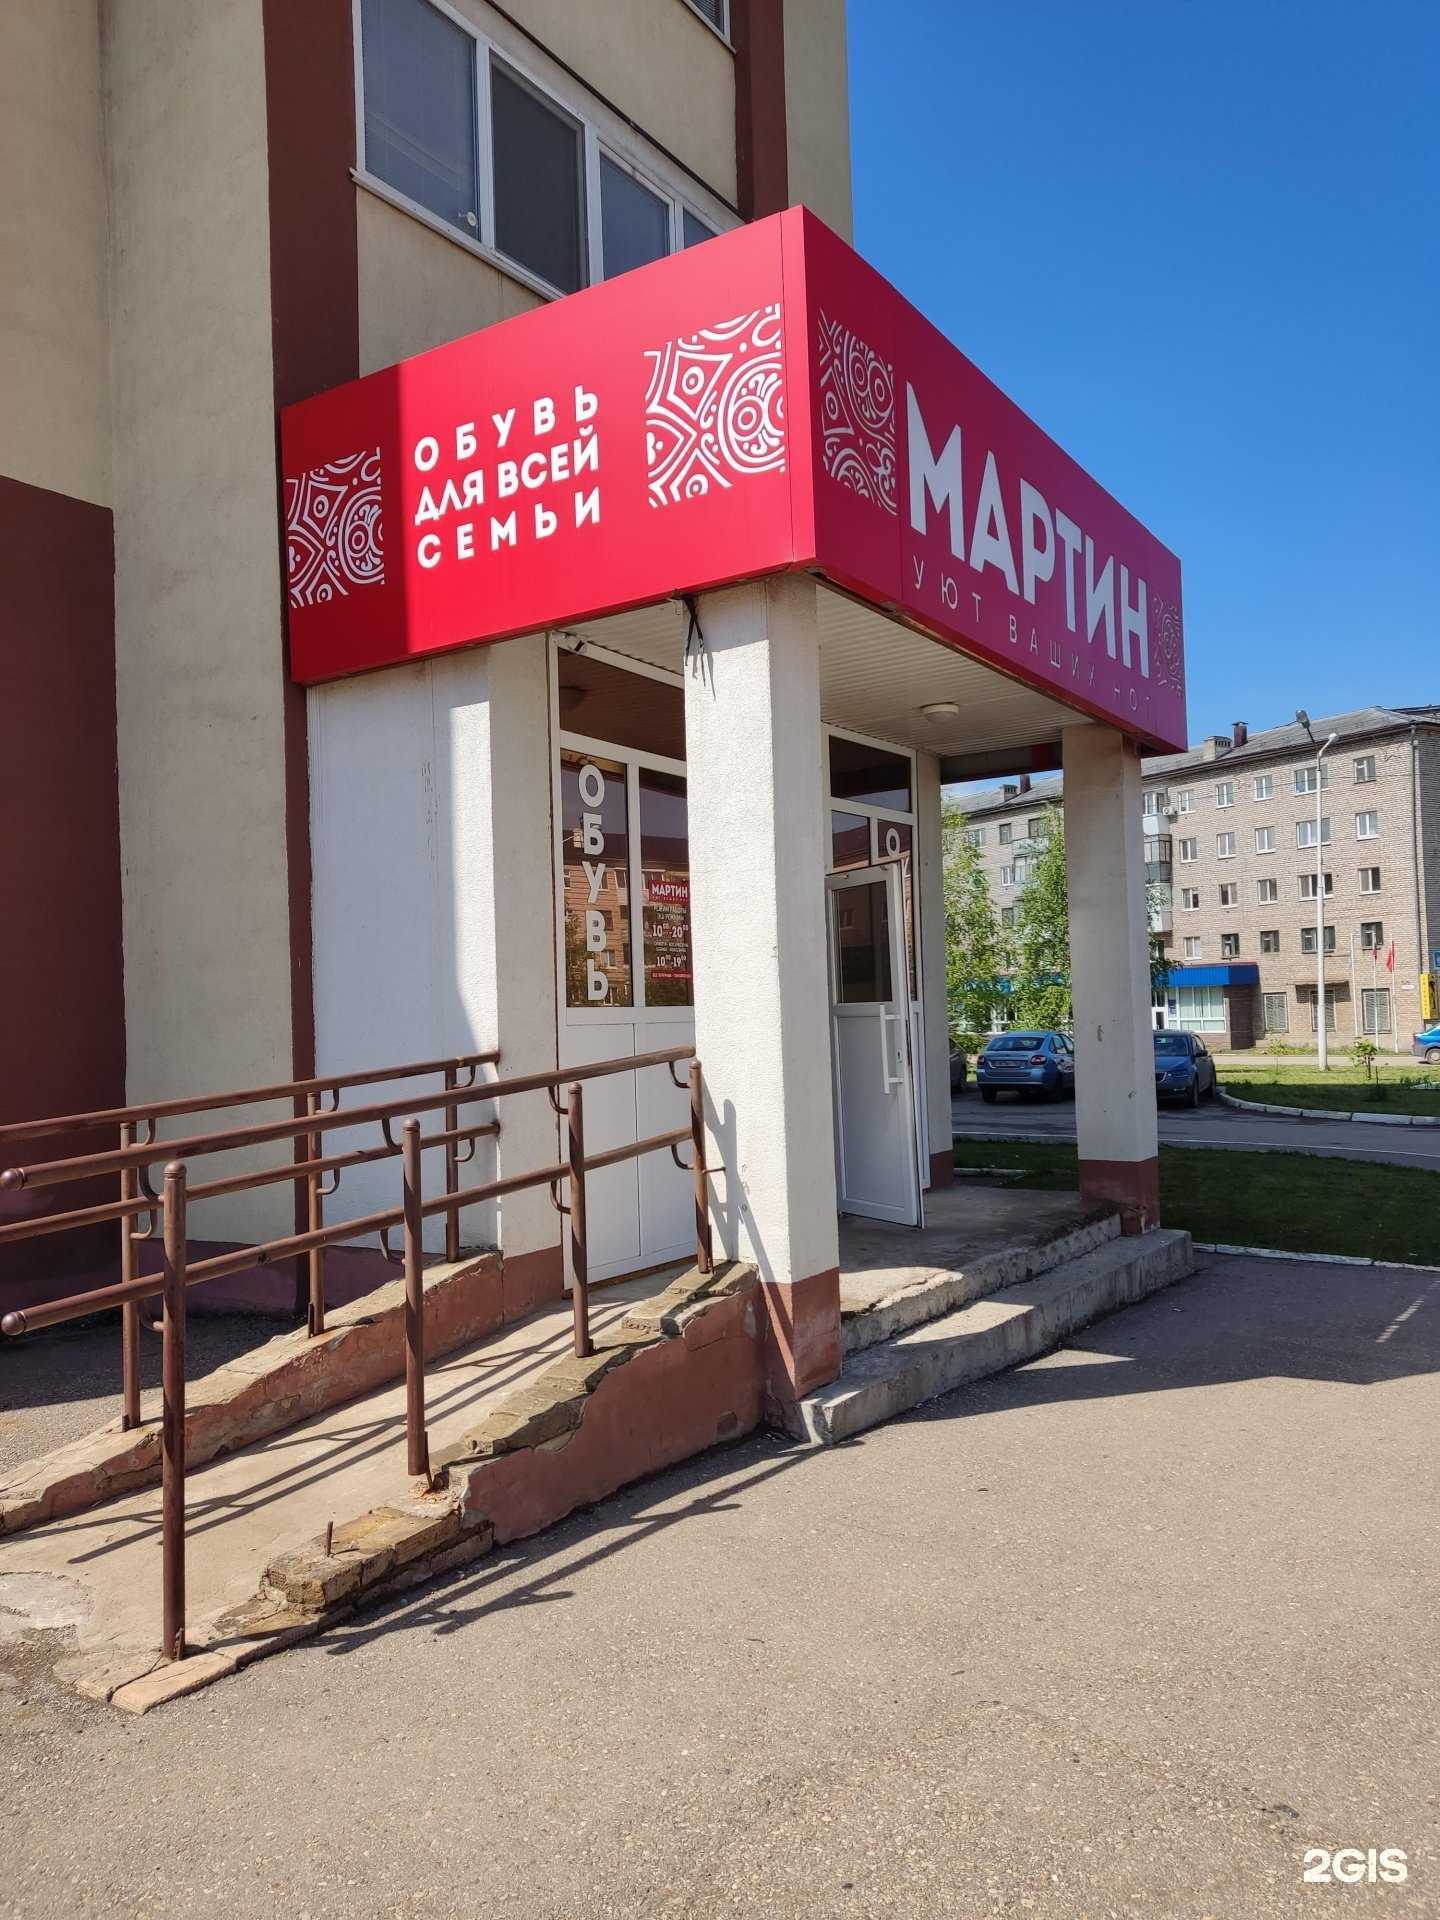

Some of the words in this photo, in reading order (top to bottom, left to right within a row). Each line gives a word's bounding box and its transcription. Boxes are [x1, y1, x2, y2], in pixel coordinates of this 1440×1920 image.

[414, 385, 598, 472] ОБУВЬ
[414, 470, 484, 526] ДЛЯ
[497, 424, 599, 498] ВСЕЙ
[417, 486, 600, 569] СЕМЬИ
[906, 381, 1150, 678] МАРТИН
[913, 555, 982, 623] УЮТ
[578, 764, 609, 1001] ОБУВЬ
[651, 883, 688, 898] МАРТИН
